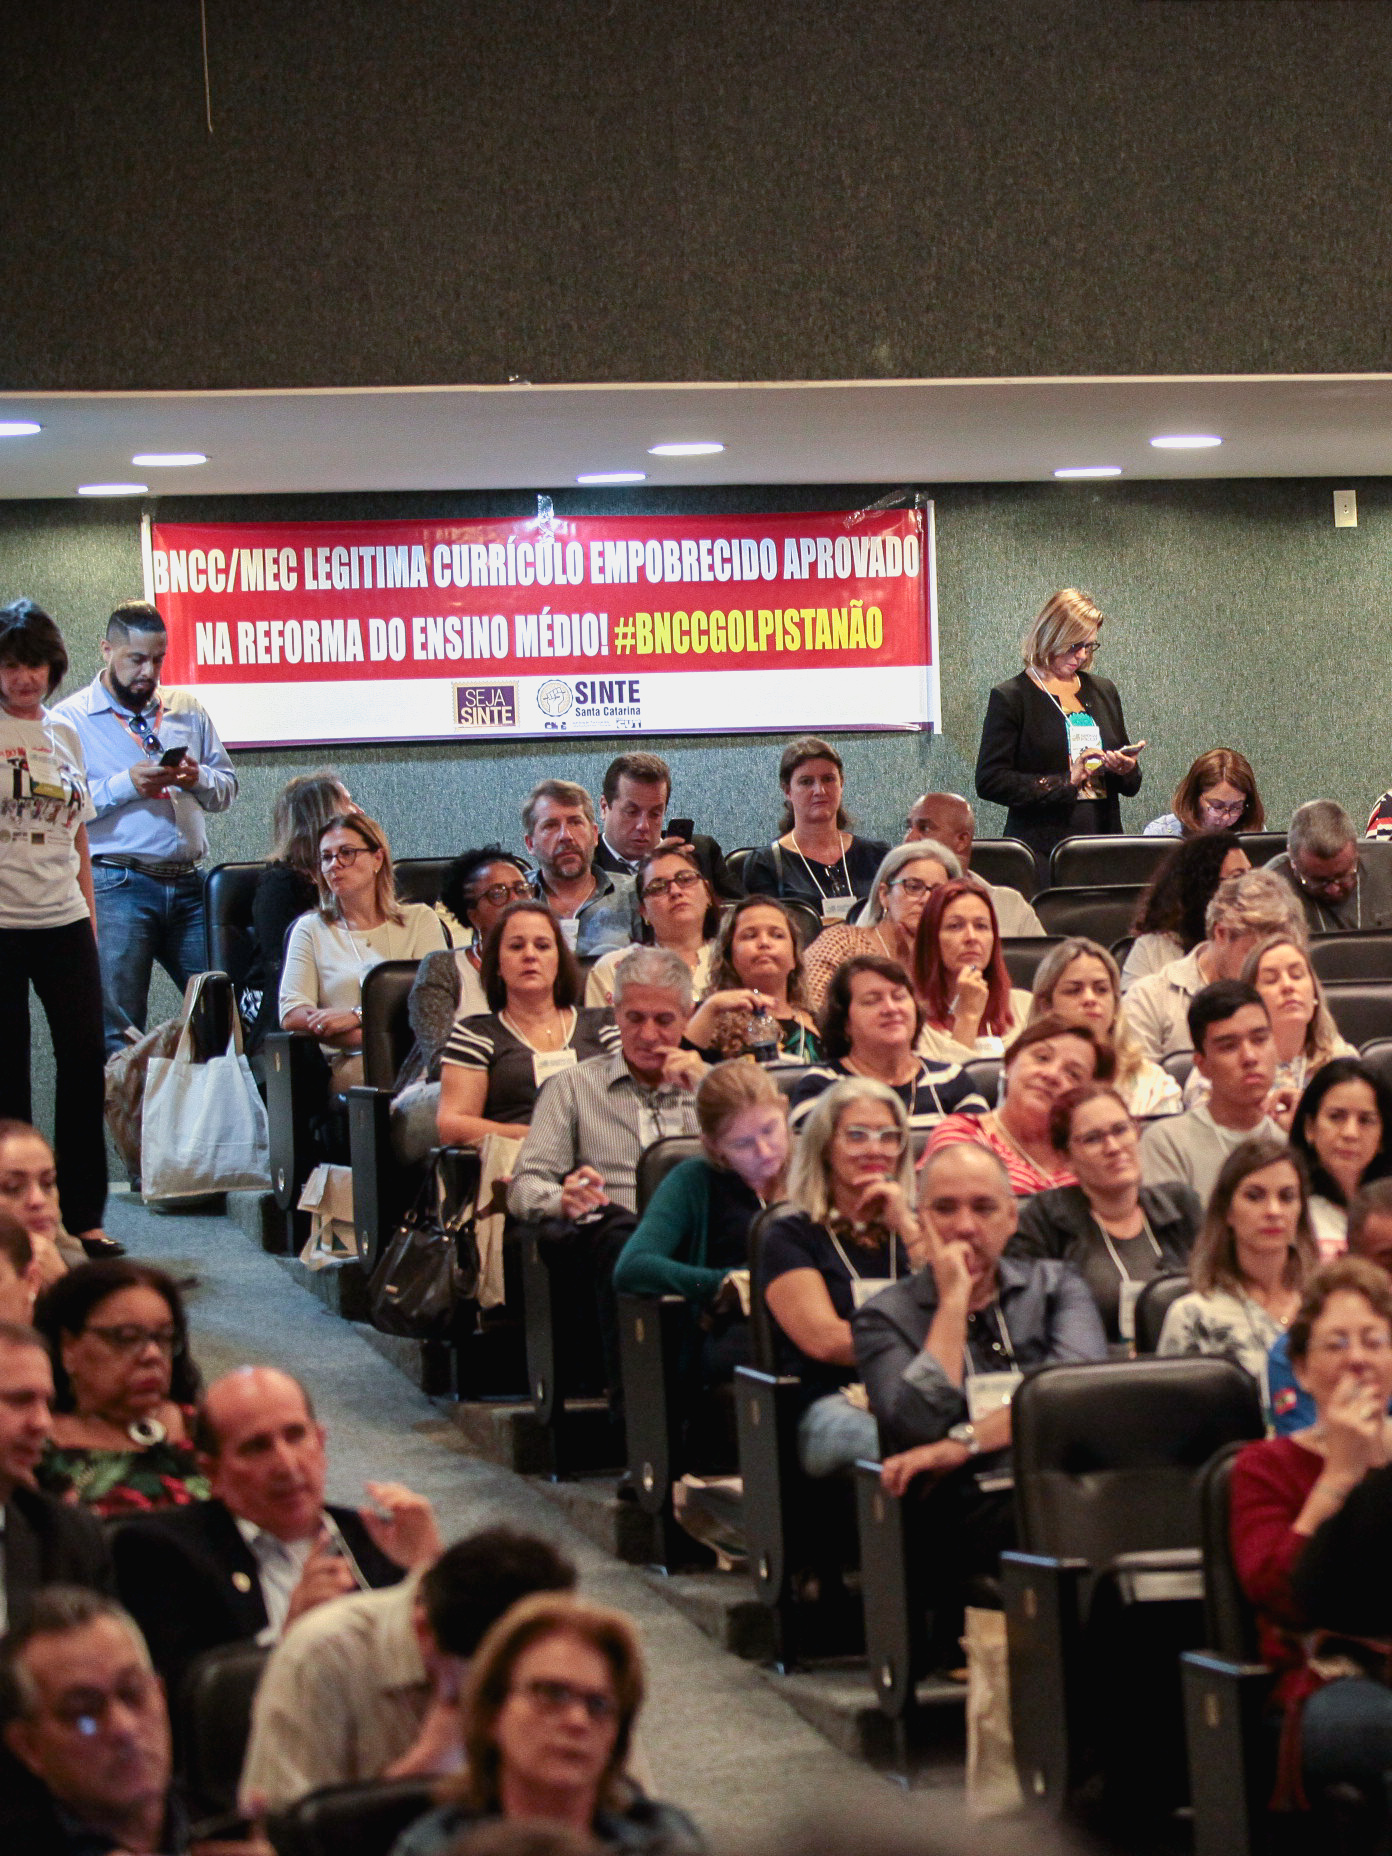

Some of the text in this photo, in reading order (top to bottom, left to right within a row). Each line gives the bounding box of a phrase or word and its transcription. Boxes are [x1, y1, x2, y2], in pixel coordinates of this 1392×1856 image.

[153, 534, 919, 593] BNCC/MEC LEGITIMA CURRÍCULO EMPOBRECIDO APROVADO
[196, 600, 884, 665] NA REFORMA DO ENSINO MÉDIO! #BNCCGOLPISTANÃO
[465, 689, 506, 707] SEJA
[575, 680, 641, 705] SINTE
[461, 705, 514, 726] SINTE
[575, 706, 641, 717] Santa Catarina
